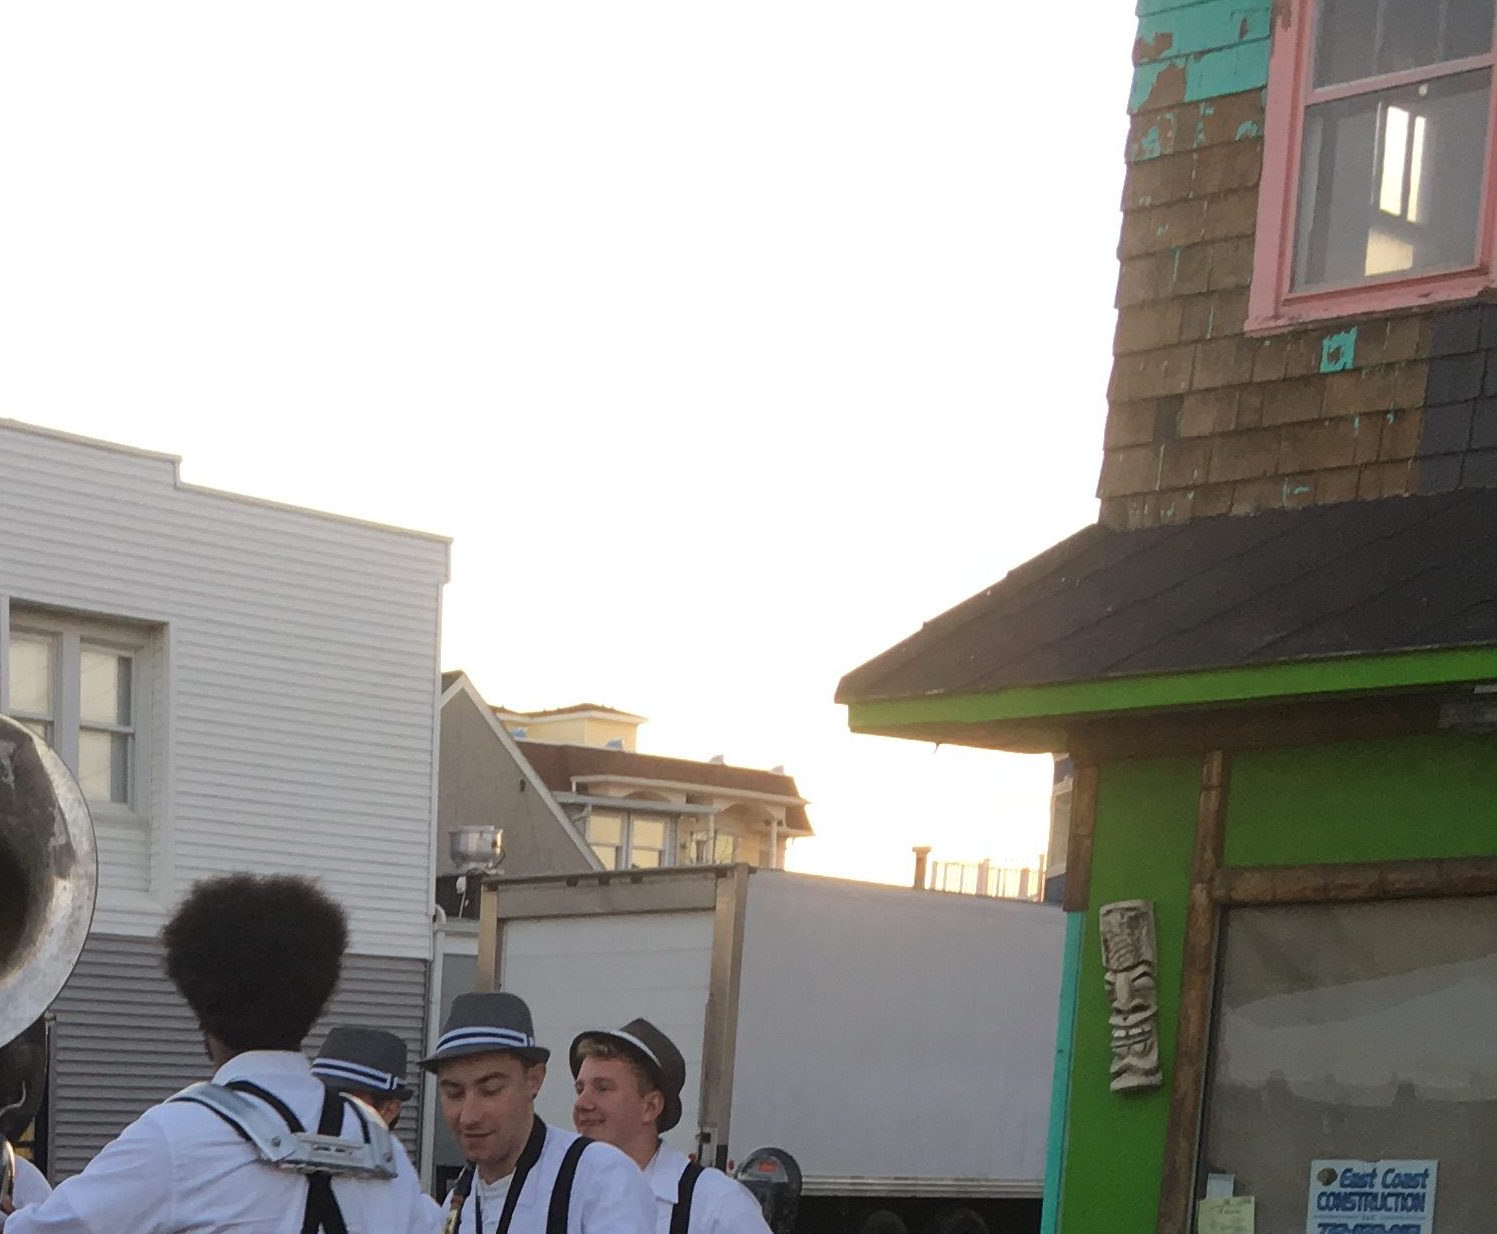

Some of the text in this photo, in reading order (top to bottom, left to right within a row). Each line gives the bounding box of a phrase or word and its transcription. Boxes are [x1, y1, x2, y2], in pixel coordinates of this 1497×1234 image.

[1340, 1168, 1430, 1189] East Coast
[1317, 1191, 1426, 1213] CONSTRUCTION
